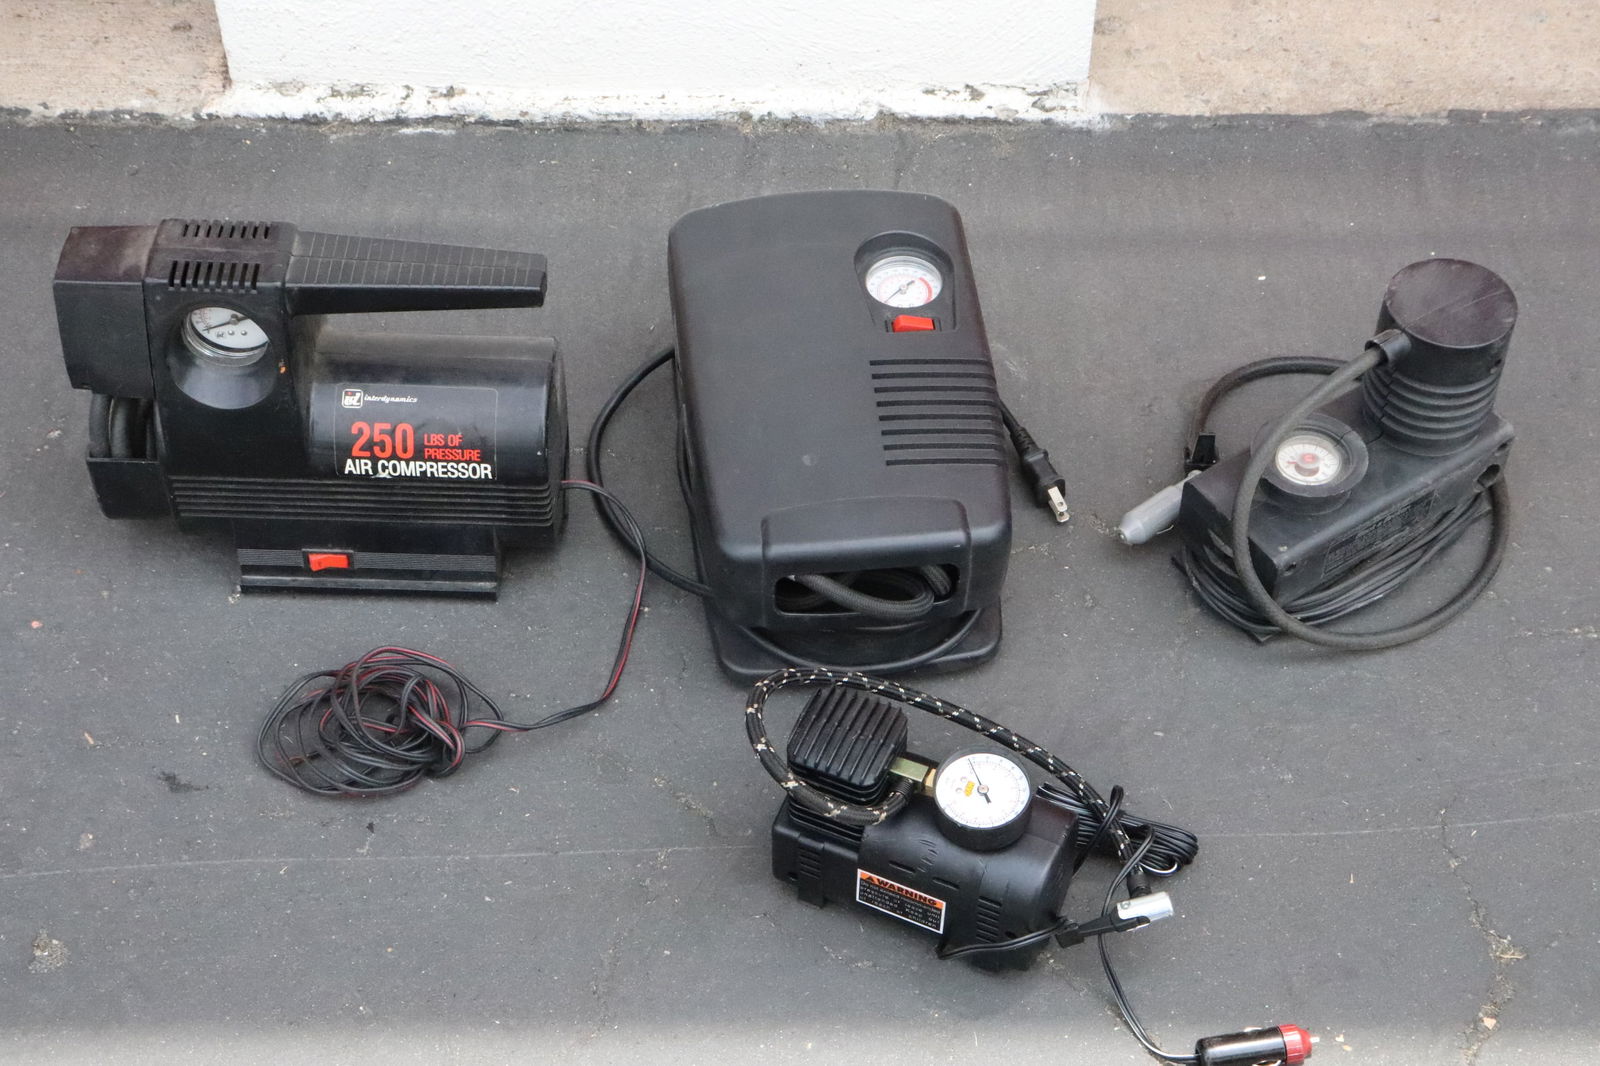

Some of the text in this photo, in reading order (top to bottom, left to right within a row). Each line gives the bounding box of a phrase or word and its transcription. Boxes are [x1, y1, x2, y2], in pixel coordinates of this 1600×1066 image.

[364, 394, 418, 404] interdynamics
[351, 421, 415, 459] 250
[424, 433, 463, 447] LBS OF
[424, 448, 481, 461] PRESSURE
[344, 459, 493, 479] AIR COMPRESSOR
[876, 878, 936, 906] WARNING
